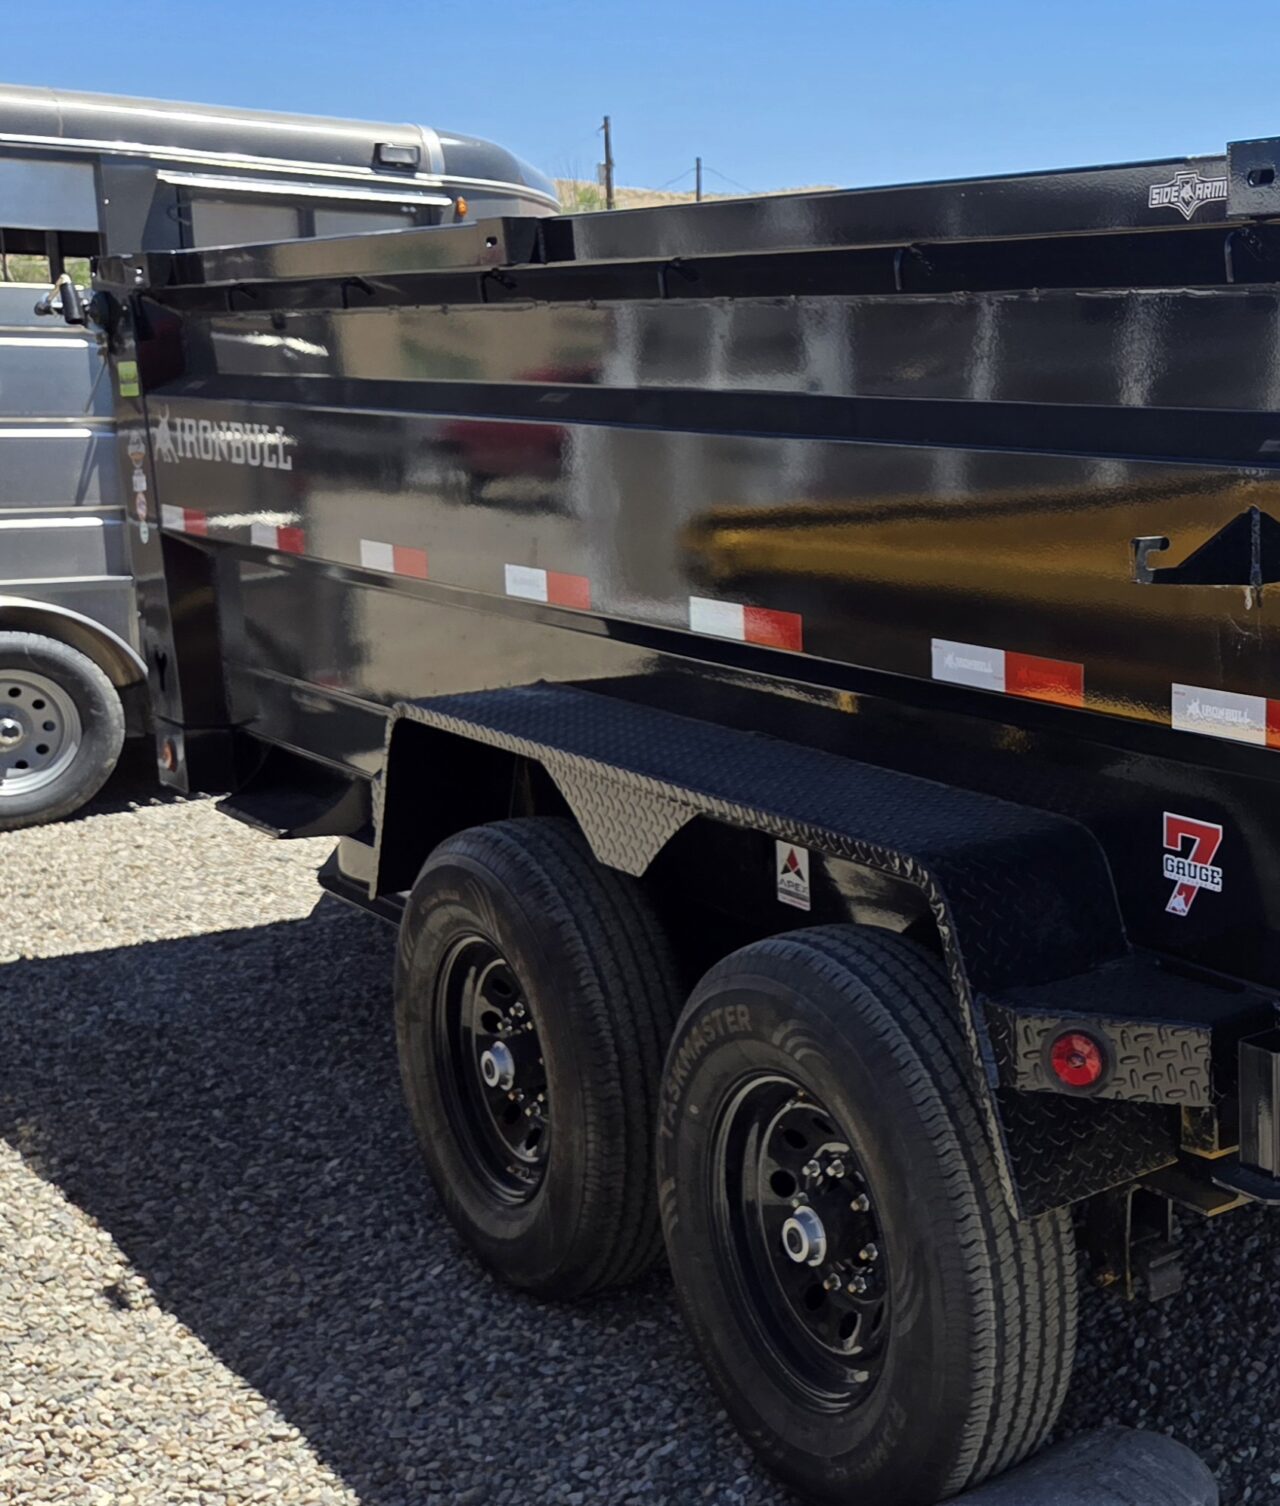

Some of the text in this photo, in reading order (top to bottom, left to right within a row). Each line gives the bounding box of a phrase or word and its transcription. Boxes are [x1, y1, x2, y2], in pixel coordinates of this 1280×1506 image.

[1151, 186, 1180, 205] SIDE
[175, 417, 293, 471] IRONBULL
[1201, 703, 1251, 723] IRONBULL
[1163, 811, 1223, 917] 7
[1164, 856, 1222, 886] GAUGE
